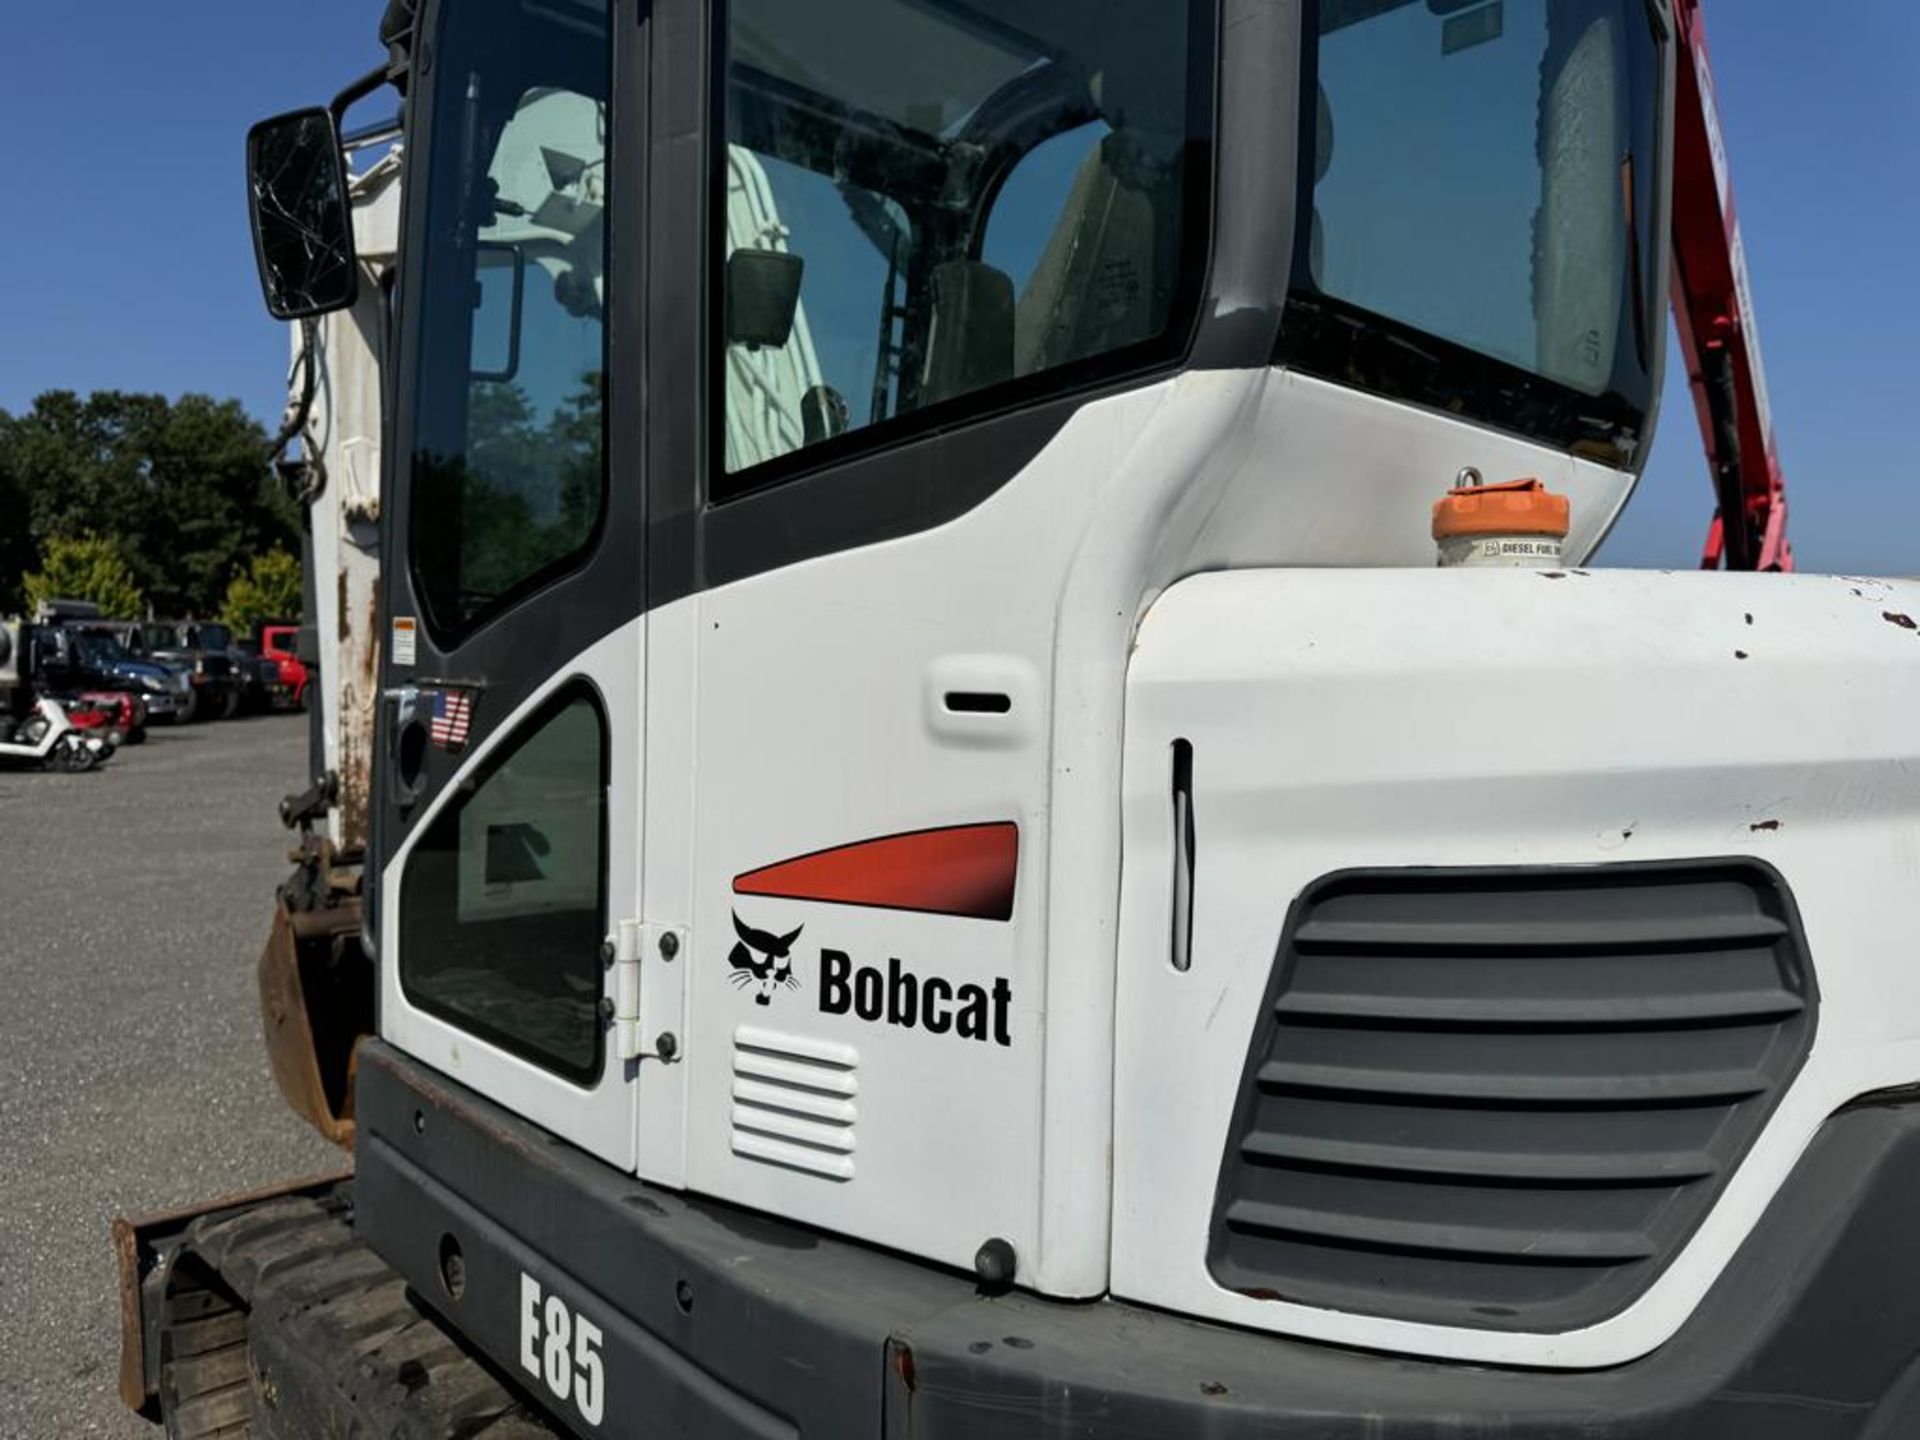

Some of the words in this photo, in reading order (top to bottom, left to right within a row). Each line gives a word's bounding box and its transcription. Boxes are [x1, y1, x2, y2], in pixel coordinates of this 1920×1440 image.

[1502, 543, 1534, 554] DIESEL
[819, 948, 1012, 1047] Bobcat
[520, 1272, 604, 1427] E85
